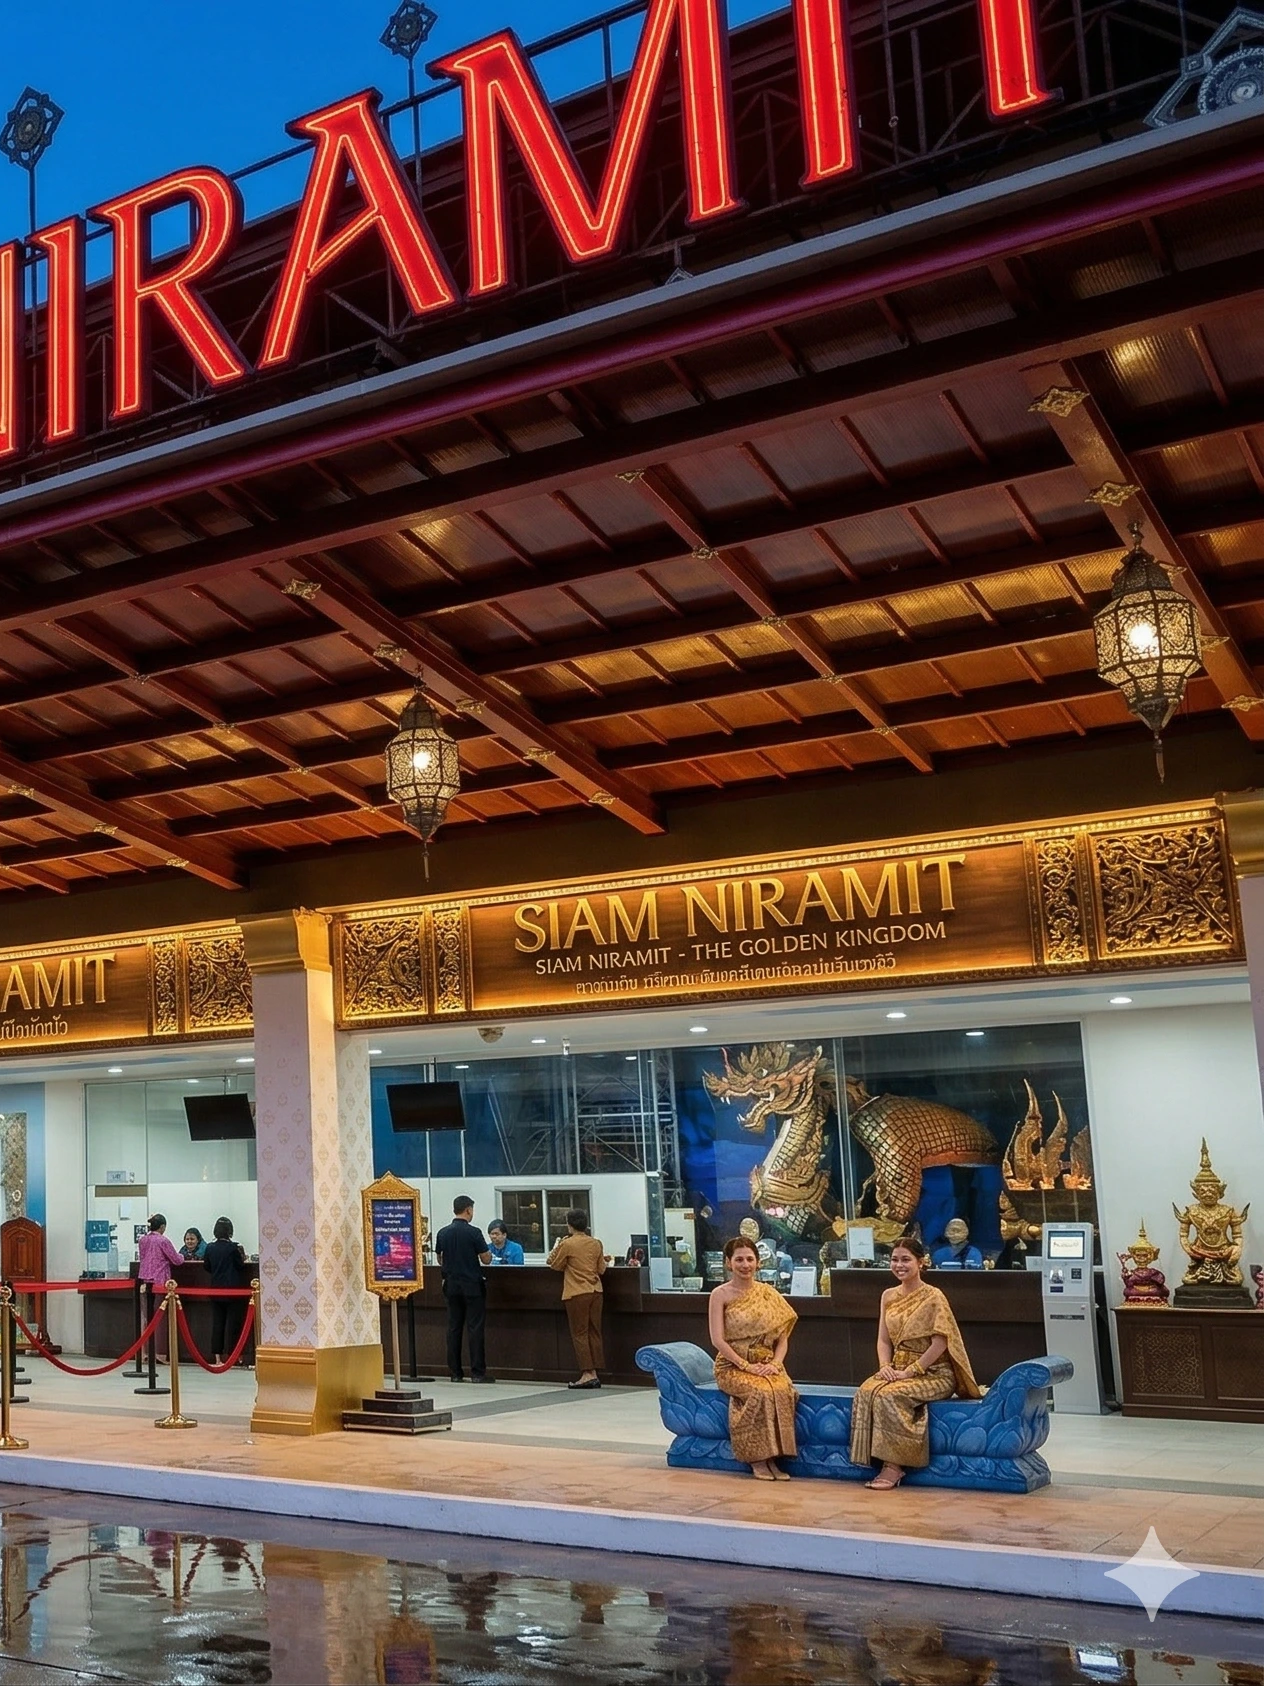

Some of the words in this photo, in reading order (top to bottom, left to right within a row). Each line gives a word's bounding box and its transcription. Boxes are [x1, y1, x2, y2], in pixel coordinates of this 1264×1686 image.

[514, 891, 660, 953] SIAM
[681, 854, 966, 937] NIRAMIT
[535, 955, 583, 976] SIAM
[588, 946, 670, 972] NIRAMIT
[690, 941, 734, 961] THE
[738, 931, 828, 956] GOLDEN
[835, 920, 947, 948] KINGDOM
